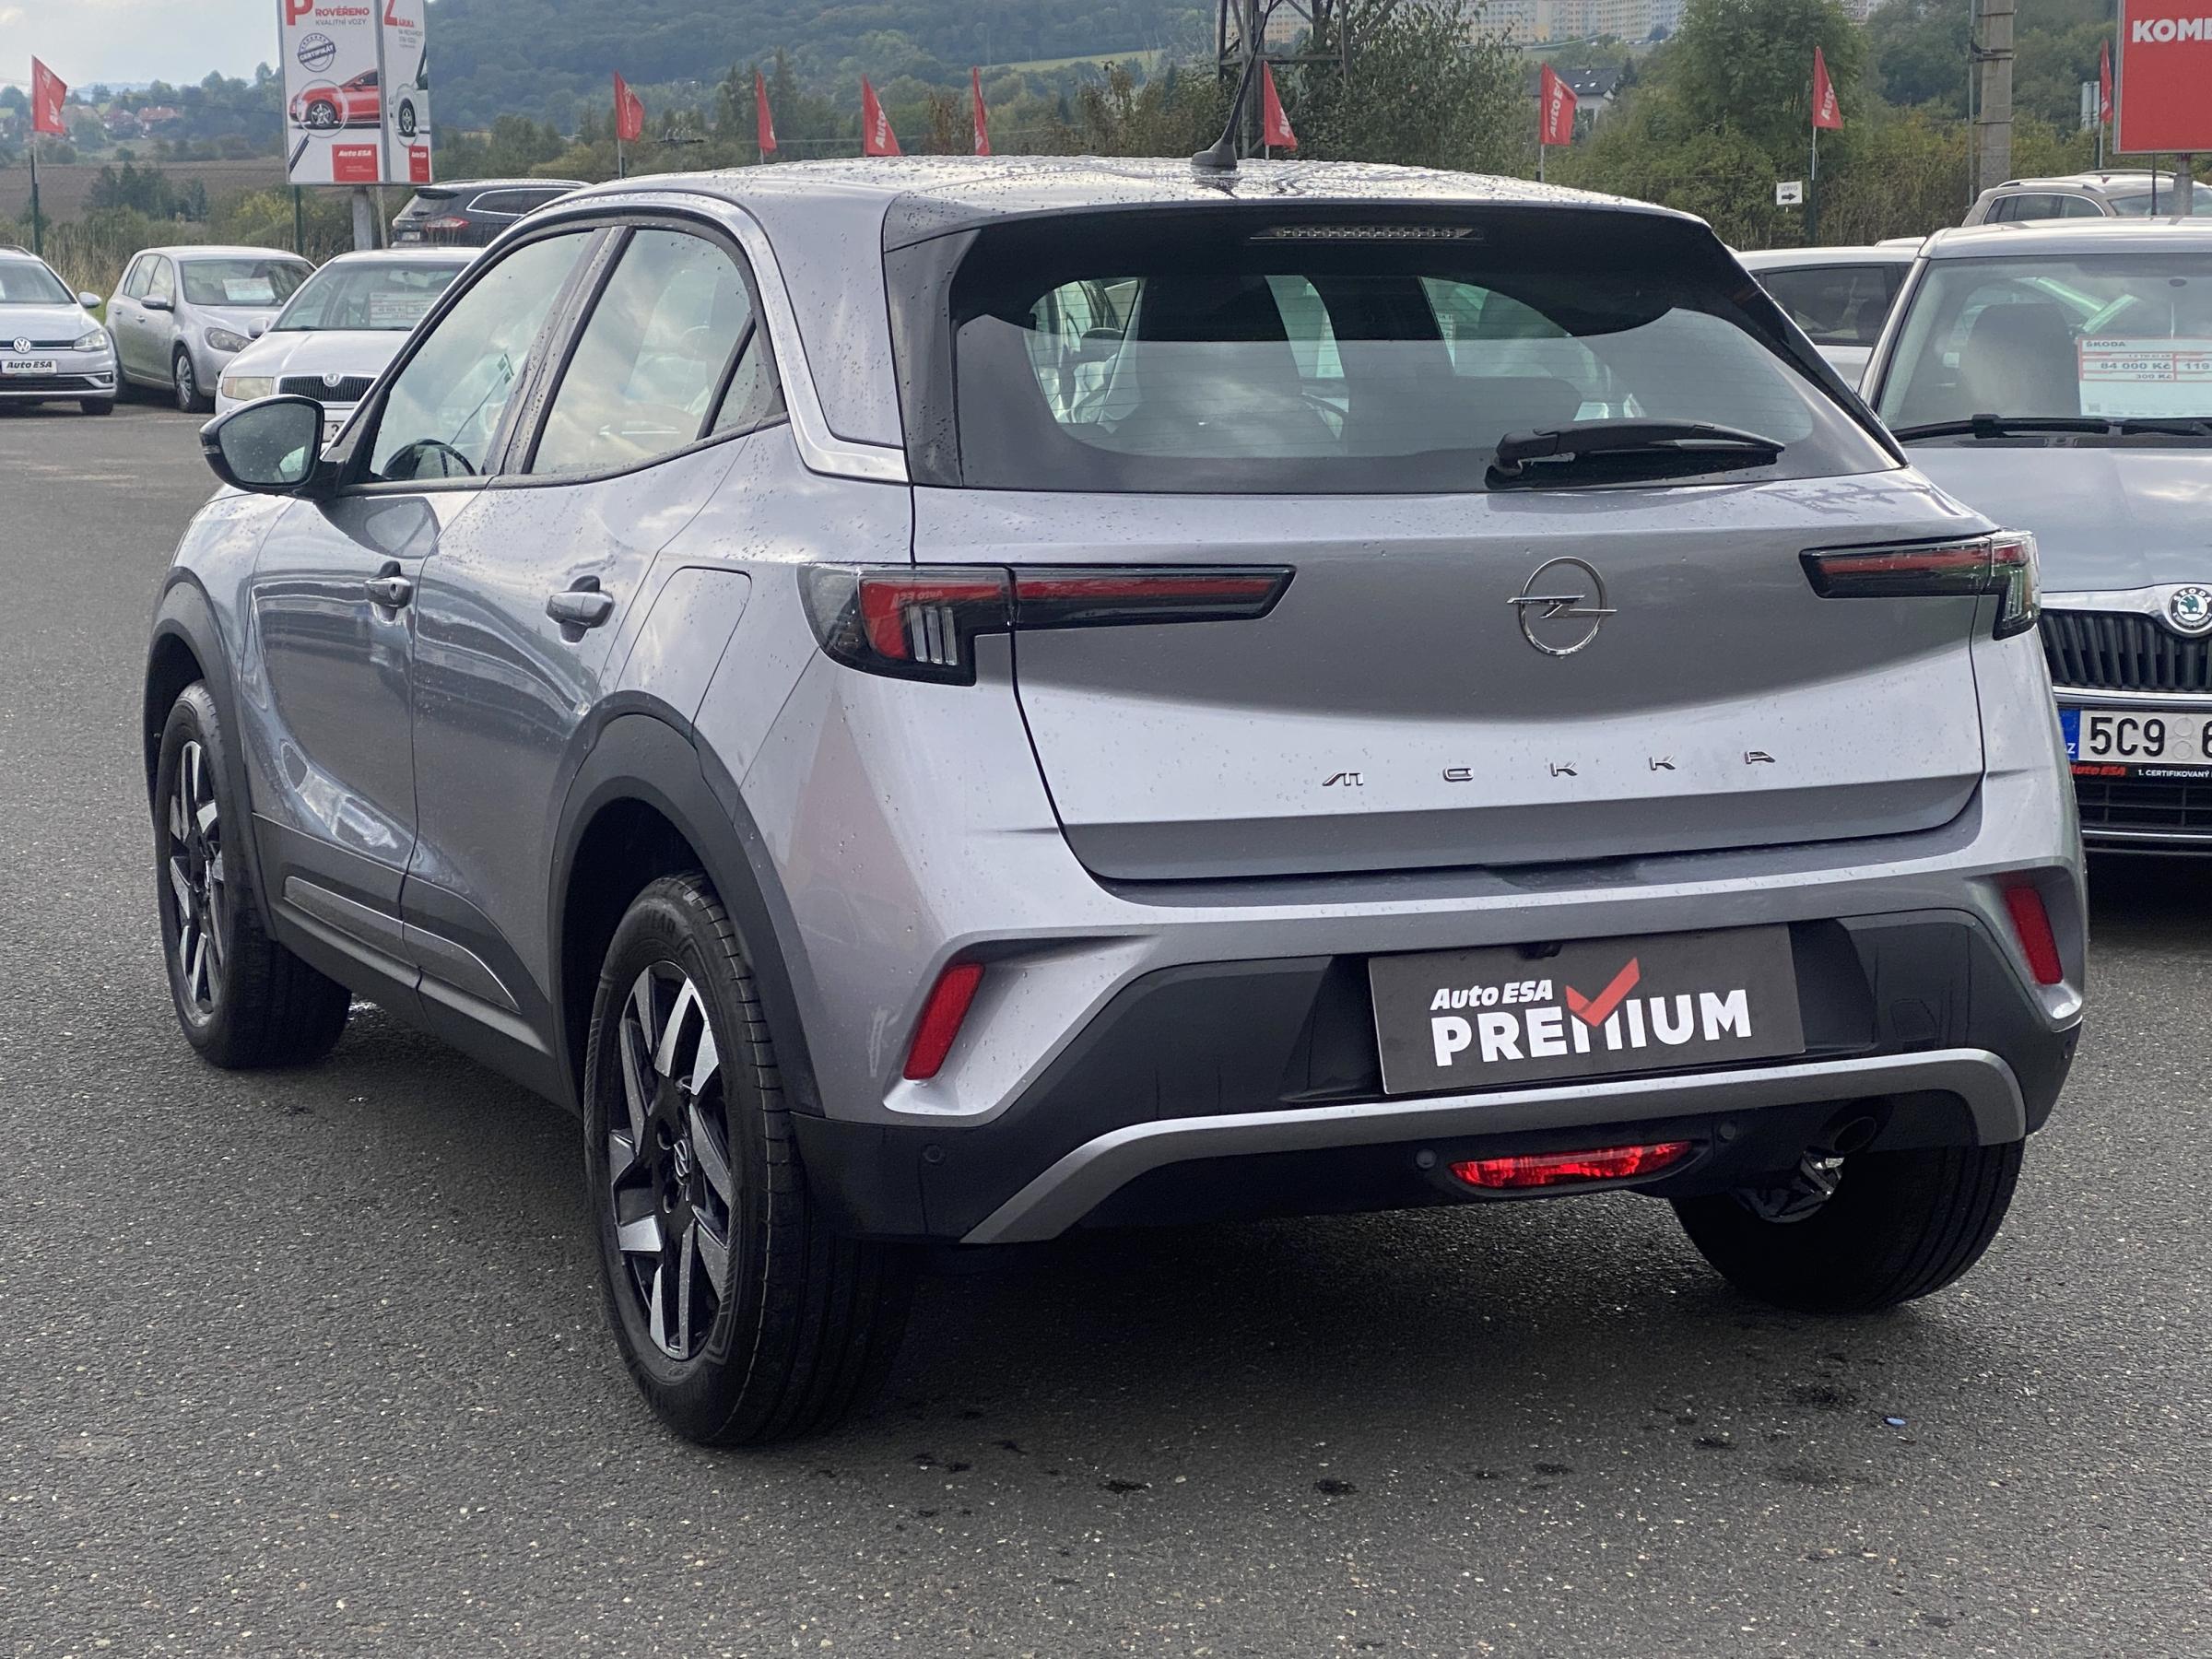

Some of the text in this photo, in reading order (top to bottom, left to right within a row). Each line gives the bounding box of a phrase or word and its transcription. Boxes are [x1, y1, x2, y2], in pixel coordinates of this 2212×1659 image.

[32, 360, 53, 369] ESA
[2089, 716, 2166, 757] 5C9
[2100, 766, 2126, 776] ESA
[2146, 768, 2210, 779] CERTIFIKOVANÝ
[1430, 979, 1554, 1011] Auto ESA
[1430, 989, 1753, 1067] PREMIUM
